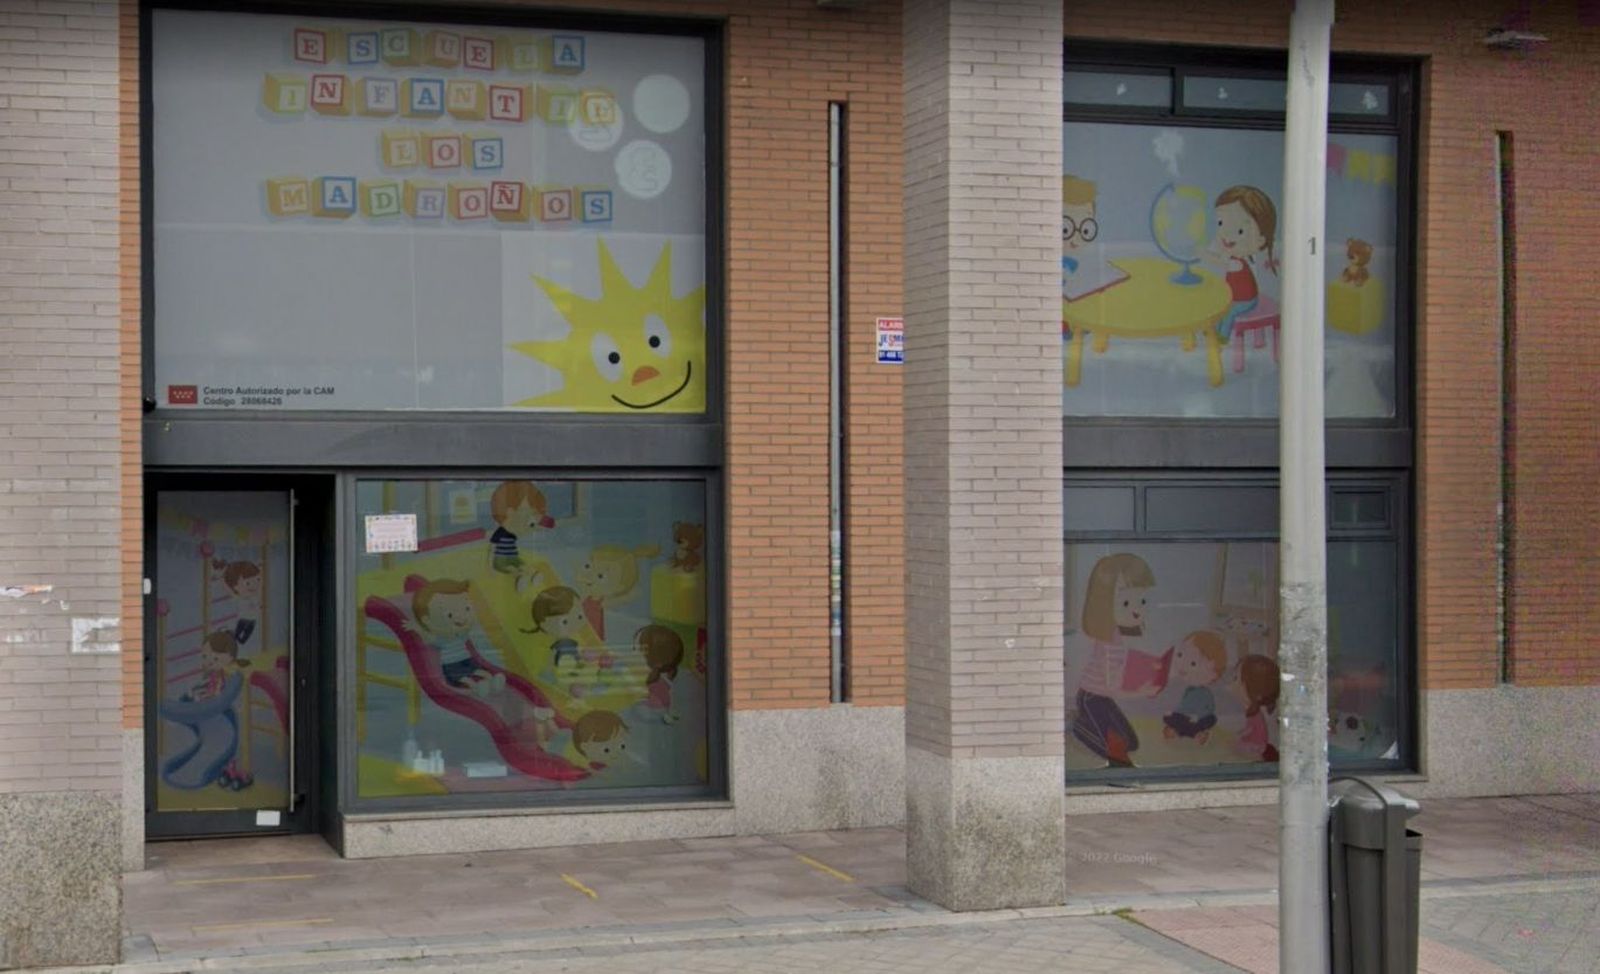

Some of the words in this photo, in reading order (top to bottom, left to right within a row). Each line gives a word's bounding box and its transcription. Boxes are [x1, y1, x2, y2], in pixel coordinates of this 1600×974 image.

[298, 32, 581, 68] ESCUELA
[391, 138, 501, 165] LOS
[274, 180, 609, 219] MADROÑOS
[1307, 236, 1316, 255] 1
[203, 386, 234, 395] Centro
[236, 386, 284, 395] Autorizado
[286, 388, 301, 397] por
[303, 386, 312, 395] la
[313, 386, 335, 395] CAM
